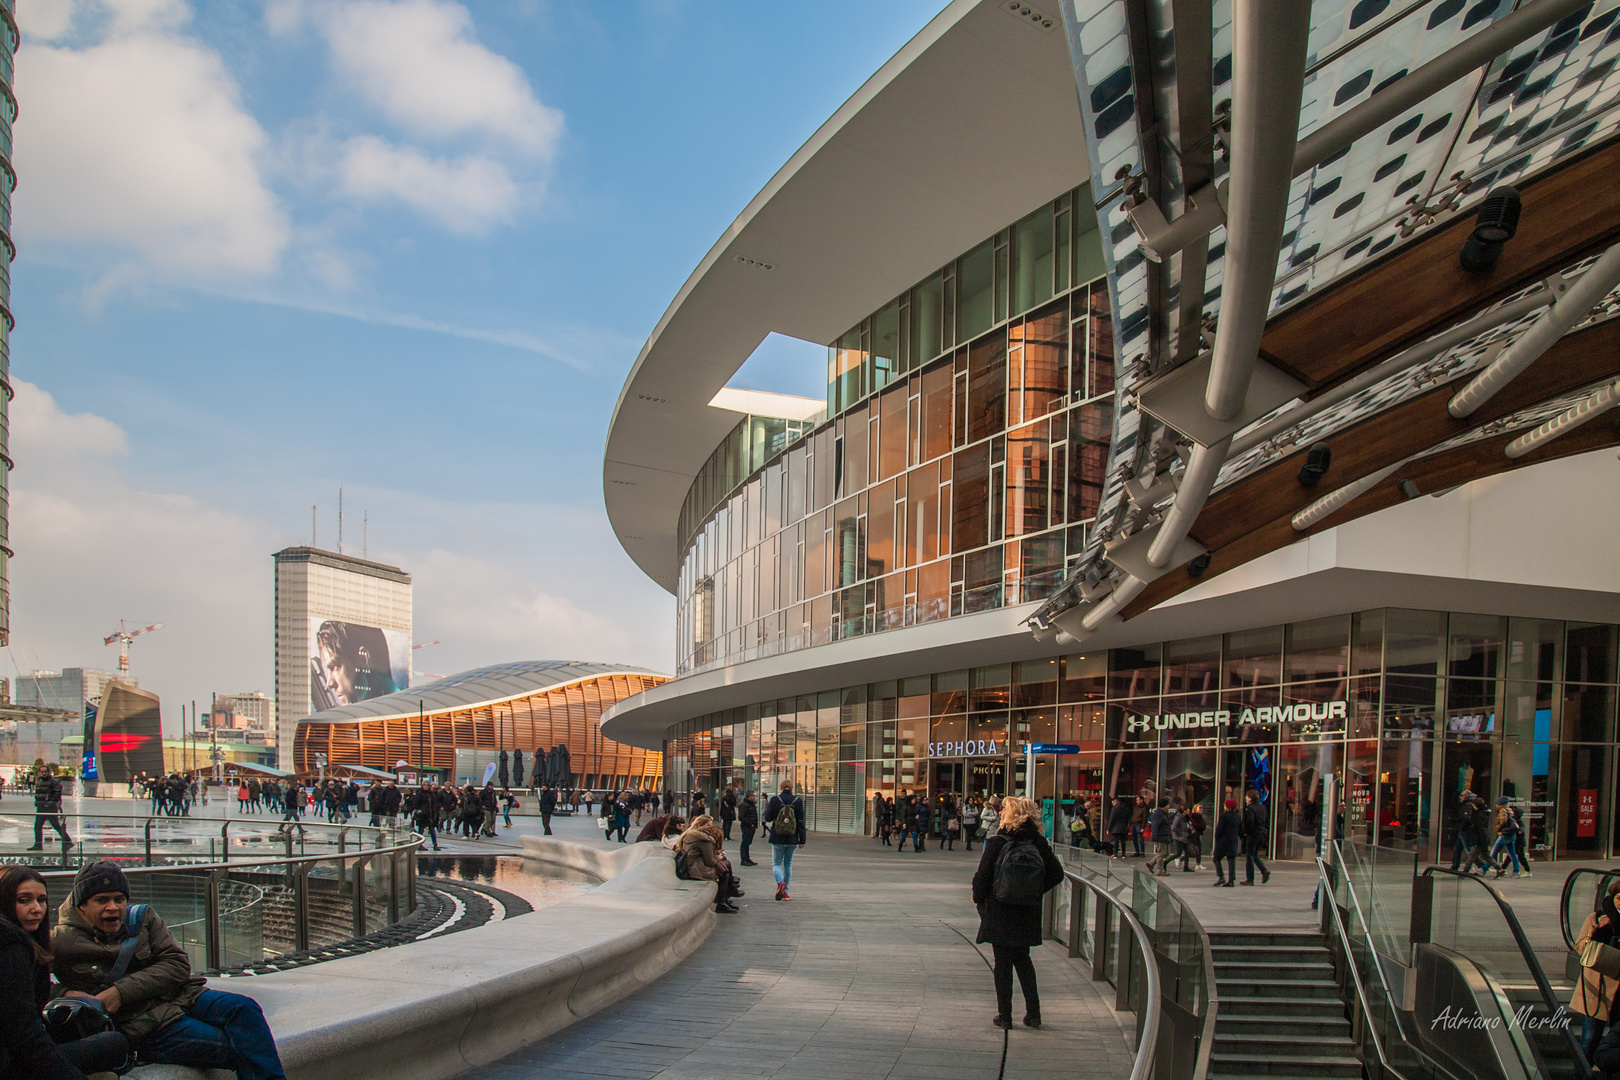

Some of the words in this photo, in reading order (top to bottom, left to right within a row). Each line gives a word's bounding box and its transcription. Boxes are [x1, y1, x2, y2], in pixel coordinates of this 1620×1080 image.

[1154, 710, 1230, 730] UNDER
[1238, 701, 1347, 725] ARMOUR
[929, 739, 997, 757] SEPHORA
